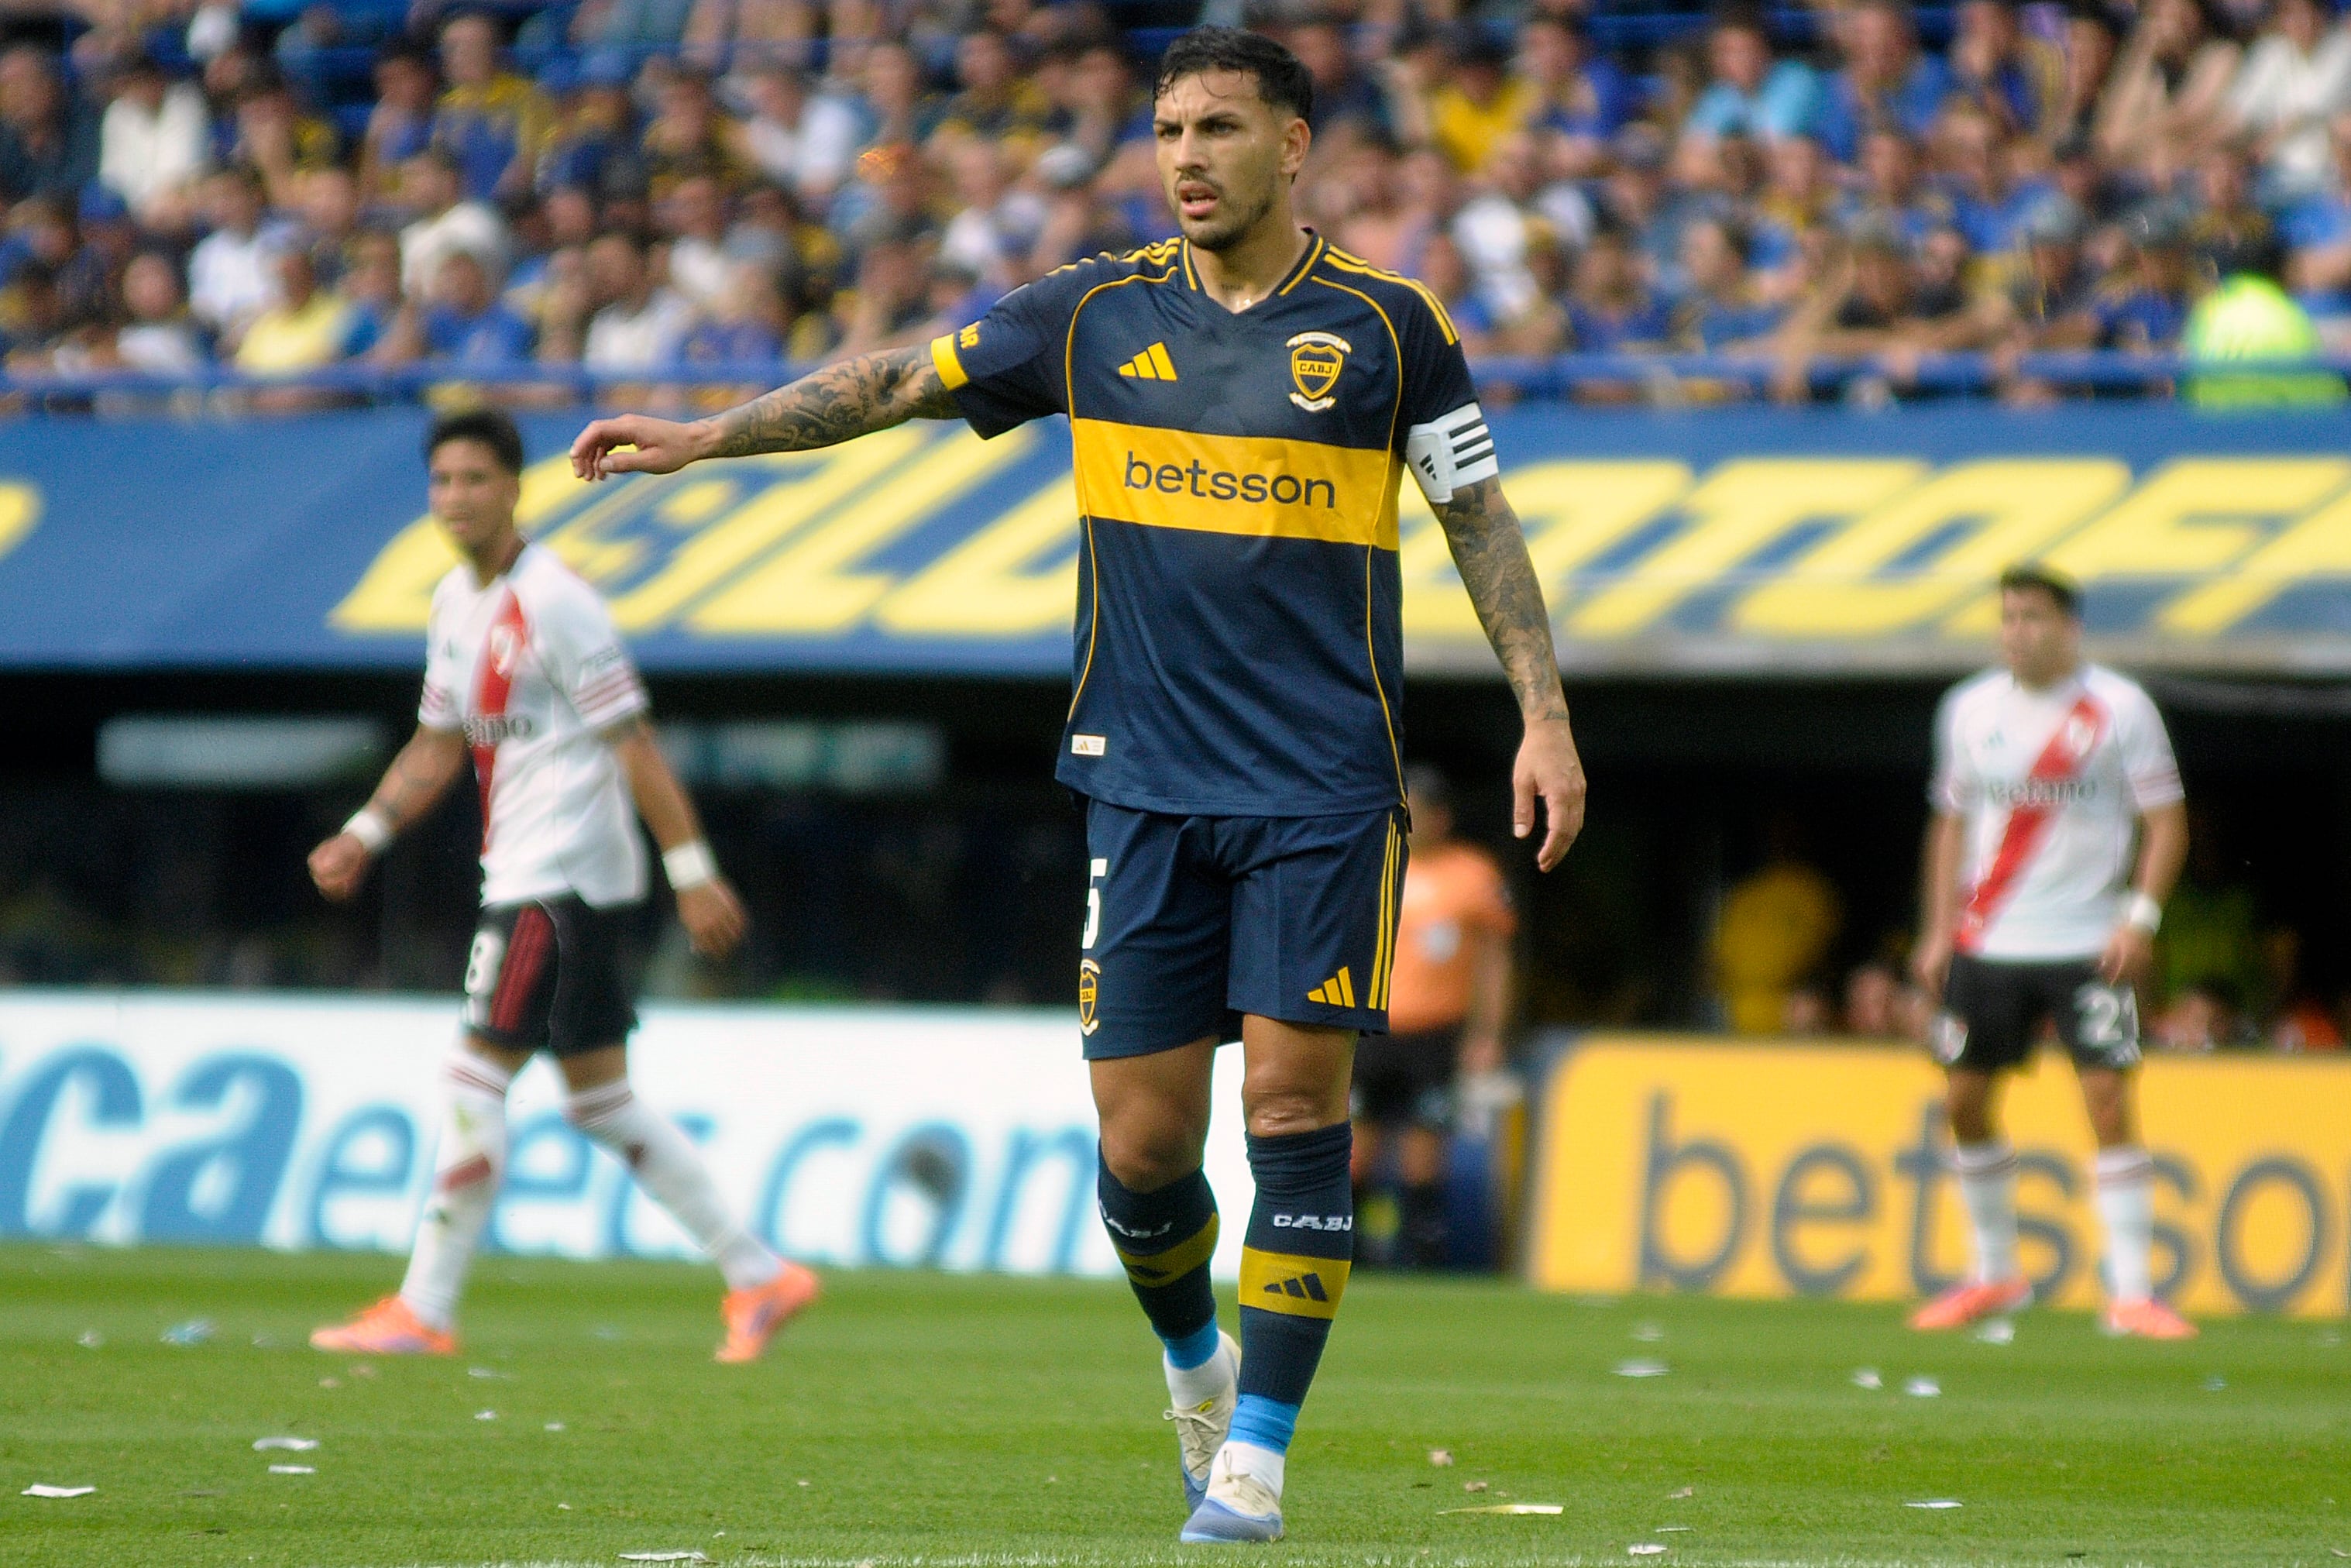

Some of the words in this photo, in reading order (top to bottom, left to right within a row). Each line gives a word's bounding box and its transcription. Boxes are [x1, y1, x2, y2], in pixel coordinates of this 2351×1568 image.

[1299, 363, 1333, 374] CABJ
[1124, 450, 1335, 508] betsson
[2078, 982, 2142, 1044] 21
[1273, 1214, 1353, 1231] CABJ
[1636, 1086, 2351, 1312] betsso
